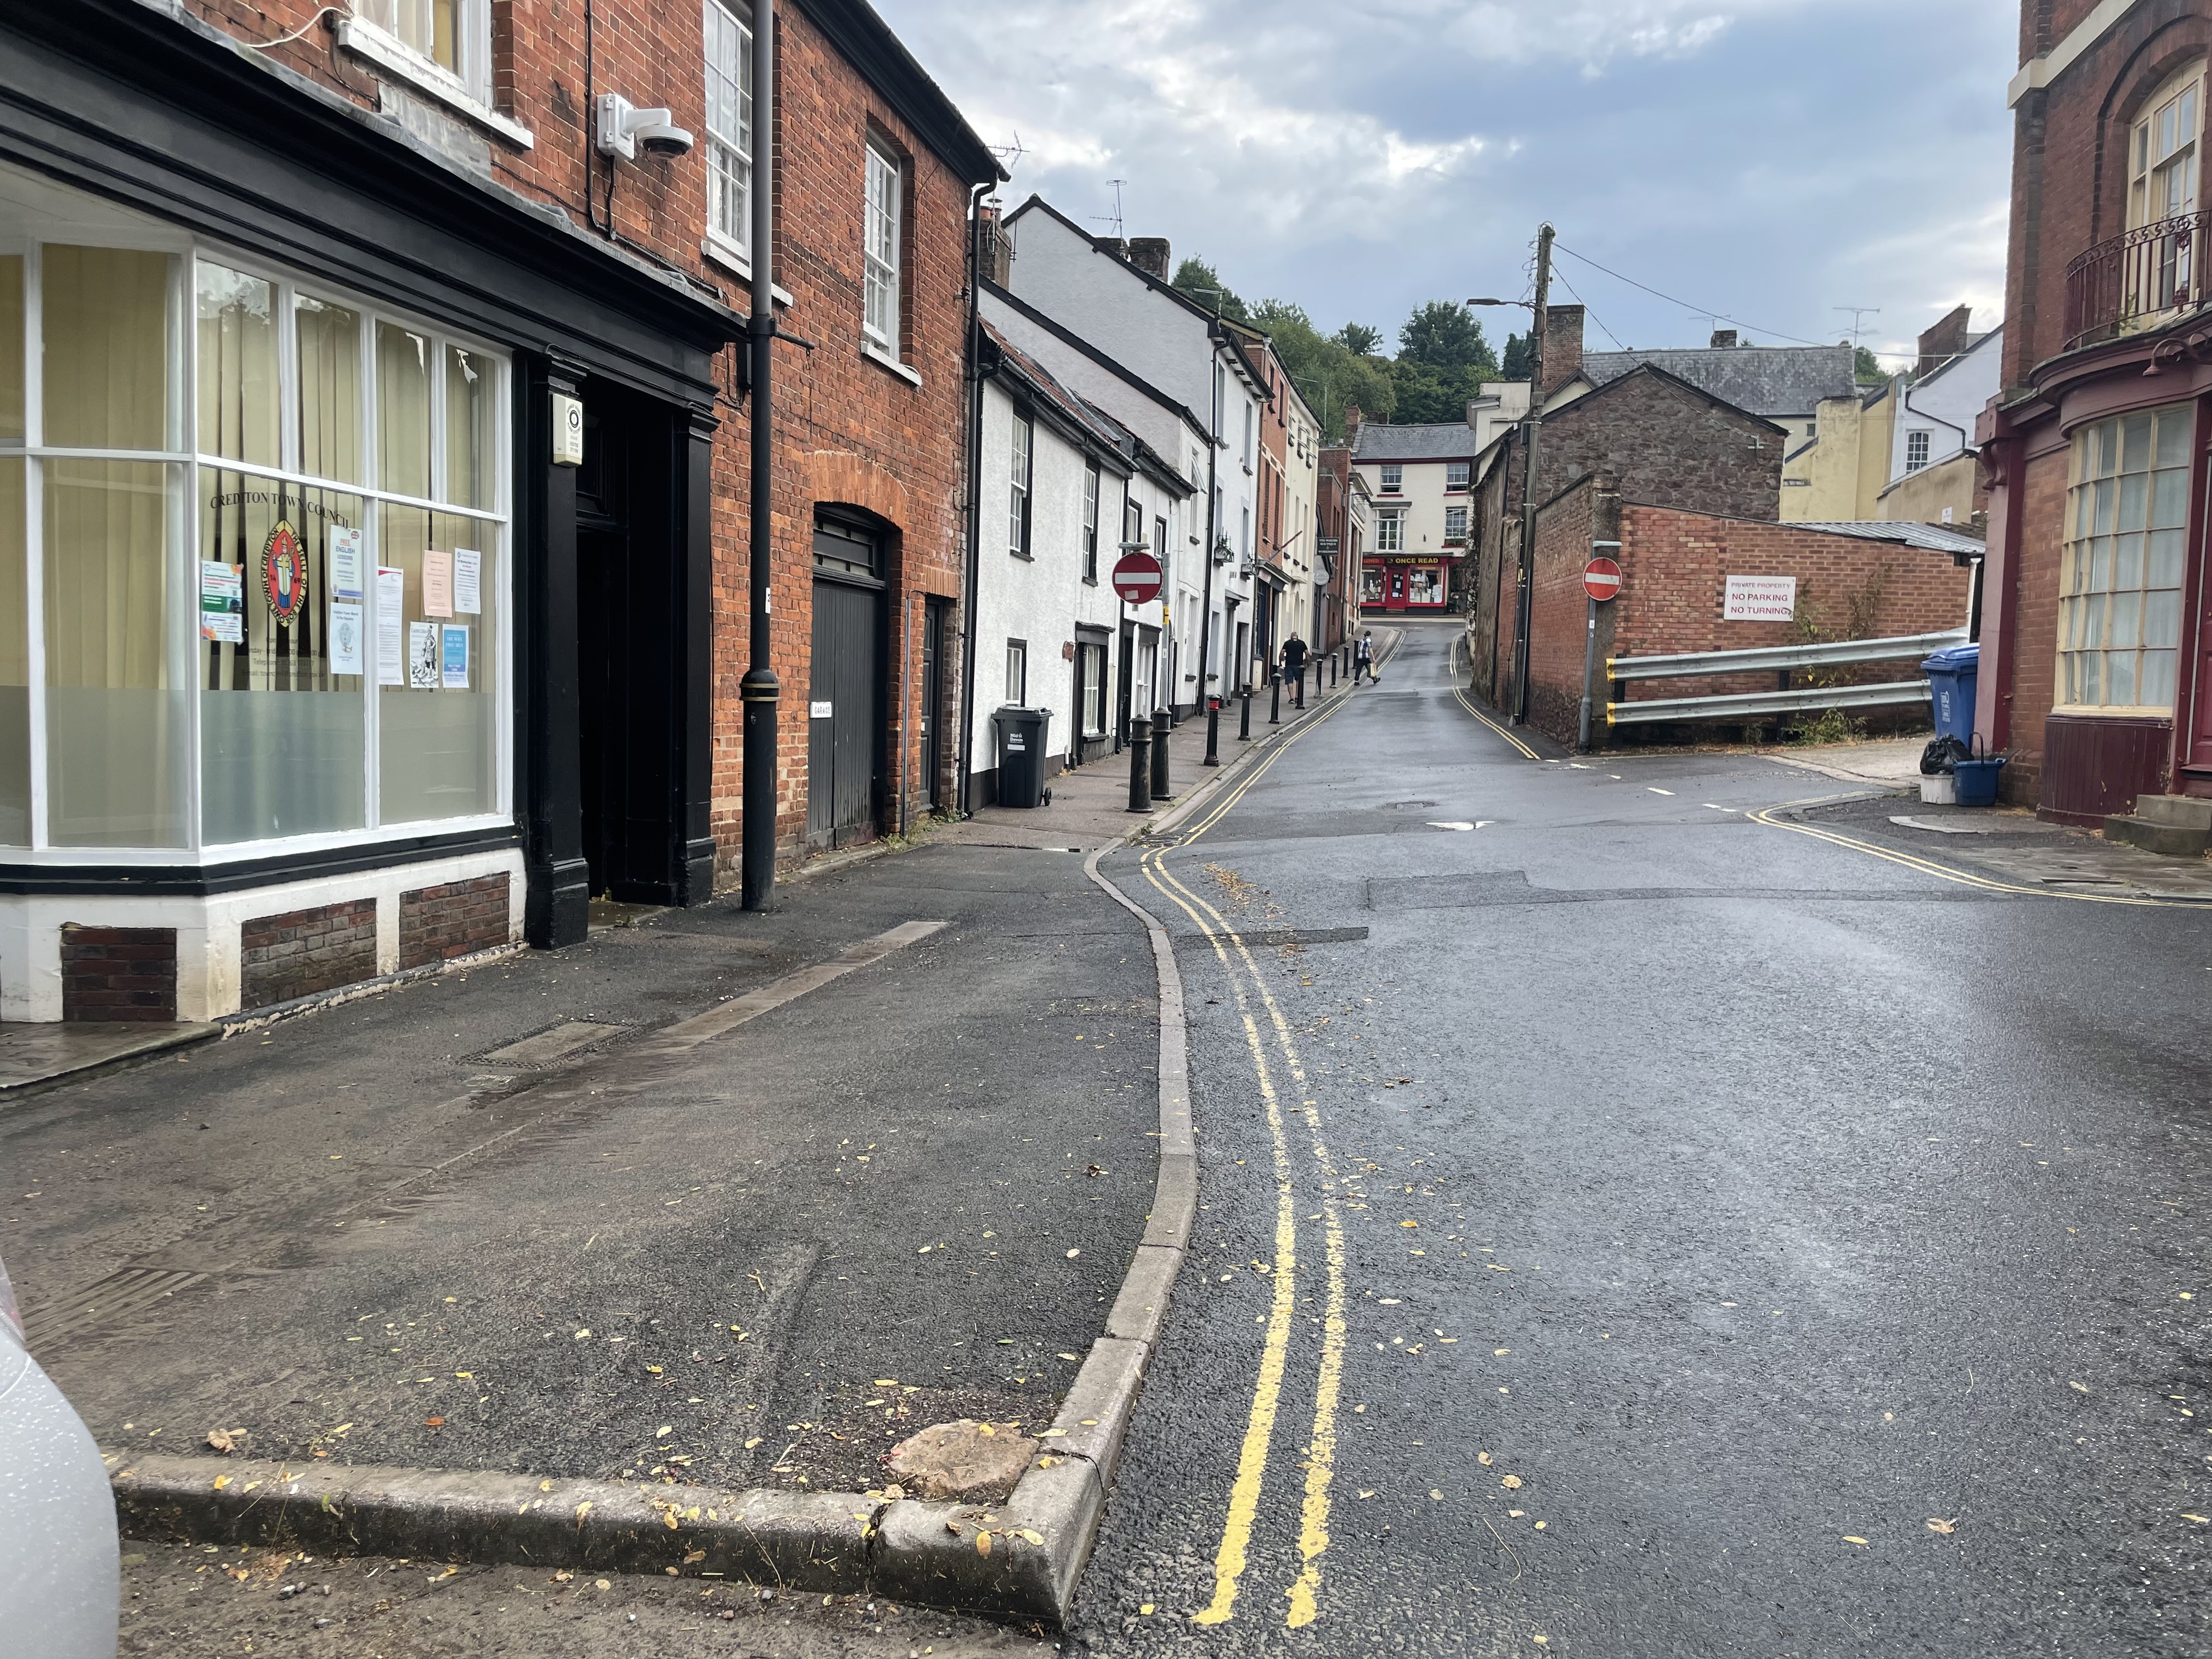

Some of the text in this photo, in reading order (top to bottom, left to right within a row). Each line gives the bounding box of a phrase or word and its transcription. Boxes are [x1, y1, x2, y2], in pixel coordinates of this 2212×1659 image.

[211, 492, 351, 532] CREDITON TOWN COUNCIL
[1747, 593, 1788, 601] PARKING
